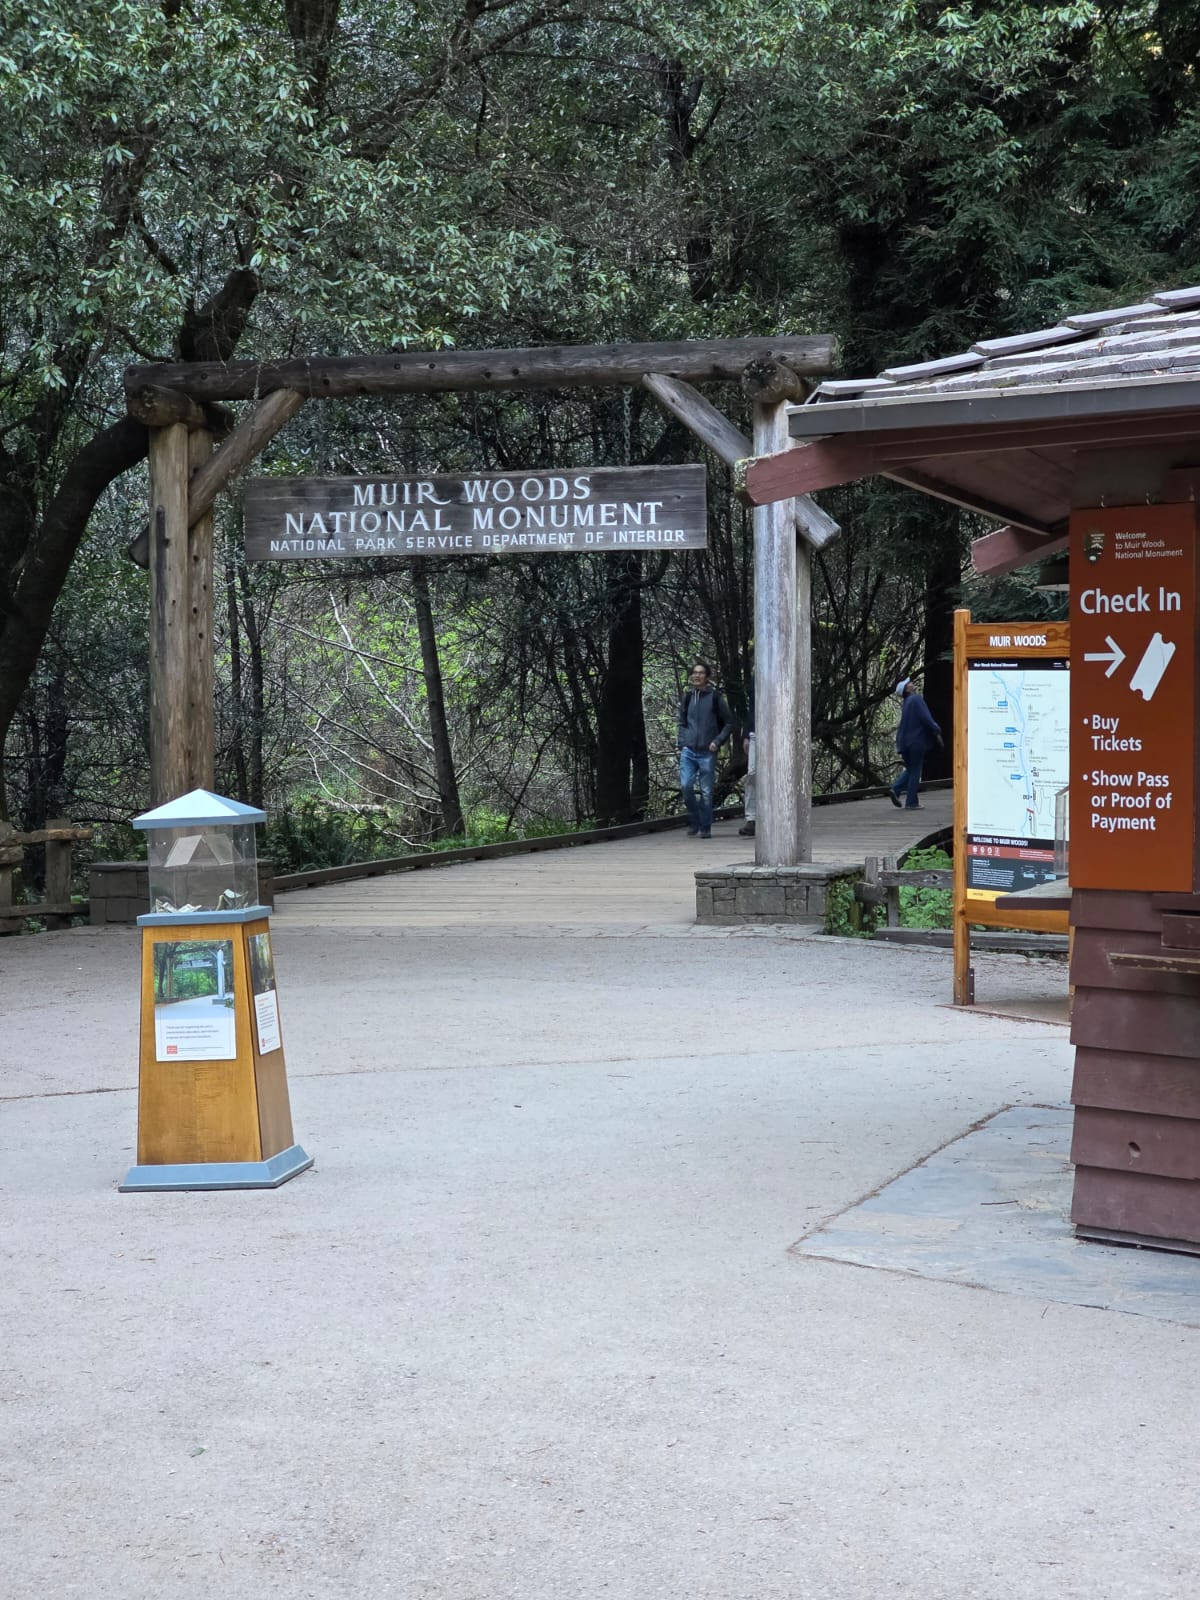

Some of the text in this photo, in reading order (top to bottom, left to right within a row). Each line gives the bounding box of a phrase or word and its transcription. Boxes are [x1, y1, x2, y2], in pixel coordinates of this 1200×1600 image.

[353, 476, 591, 506] MUIR WOODS
[285, 501, 664, 535] NATIONAL MONUMENT
[270, 529, 686, 552] NATIONAL PARK SERVICE DEPARTMENT OF INTERIOR
[1115, 532, 1147, 540] Welcome
[1124, 541, 1140, 549] Muir
[1142, 539, 1165, 549] Woods
[1115, 549, 1183, 559] National Monument
[1080, 586, 1181, 614] Check In
[989, 635, 1047, 647] MUIR WOODS
[1092, 714, 1119, 734] Buy
[1091, 735, 1142, 751] Tickets
[1091, 770, 1169, 787] Show Pass
[1091, 792, 1172, 809] or Proof of
[1091, 813, 1156, 833] Payment
